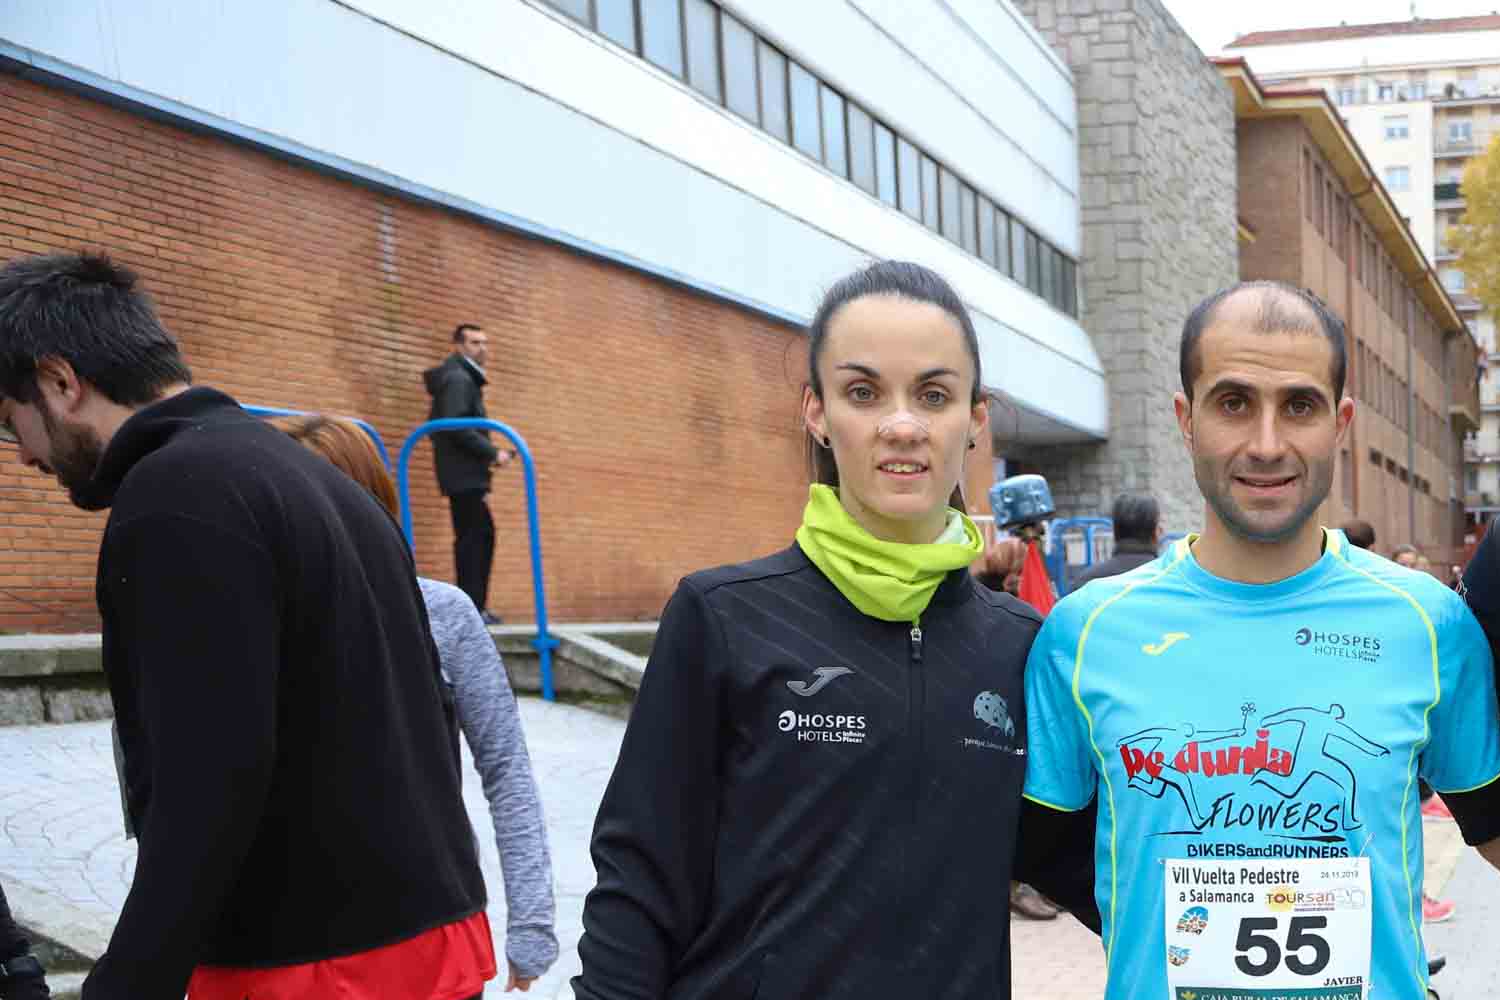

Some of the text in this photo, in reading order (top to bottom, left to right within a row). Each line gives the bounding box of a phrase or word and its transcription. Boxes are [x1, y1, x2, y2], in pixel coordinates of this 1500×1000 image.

[1314, 631, 1381, 651] HOSPES
[1314, 645, 1358, 660] HOTELS
[798, 714, 866, 729] HOSPES
[798, 731, 842, 742] HOTELS
[1209, 793, 1340, 833] FLOWERS
[1187, 844, 1349, 859] BIKERSandRUNNERS
[1172, 866, 1189, 884] VII
[1193, 867, 1236, 885] Vuelta
[1240, 866, 1300, 885] Pedestre
[1179, 891, 1187, 902] a
[1189, 888, 1255, 903] Salamanca
[1234, 915, 1331, 977] 55
[1323, 975, 1364, 987] JAVIER
